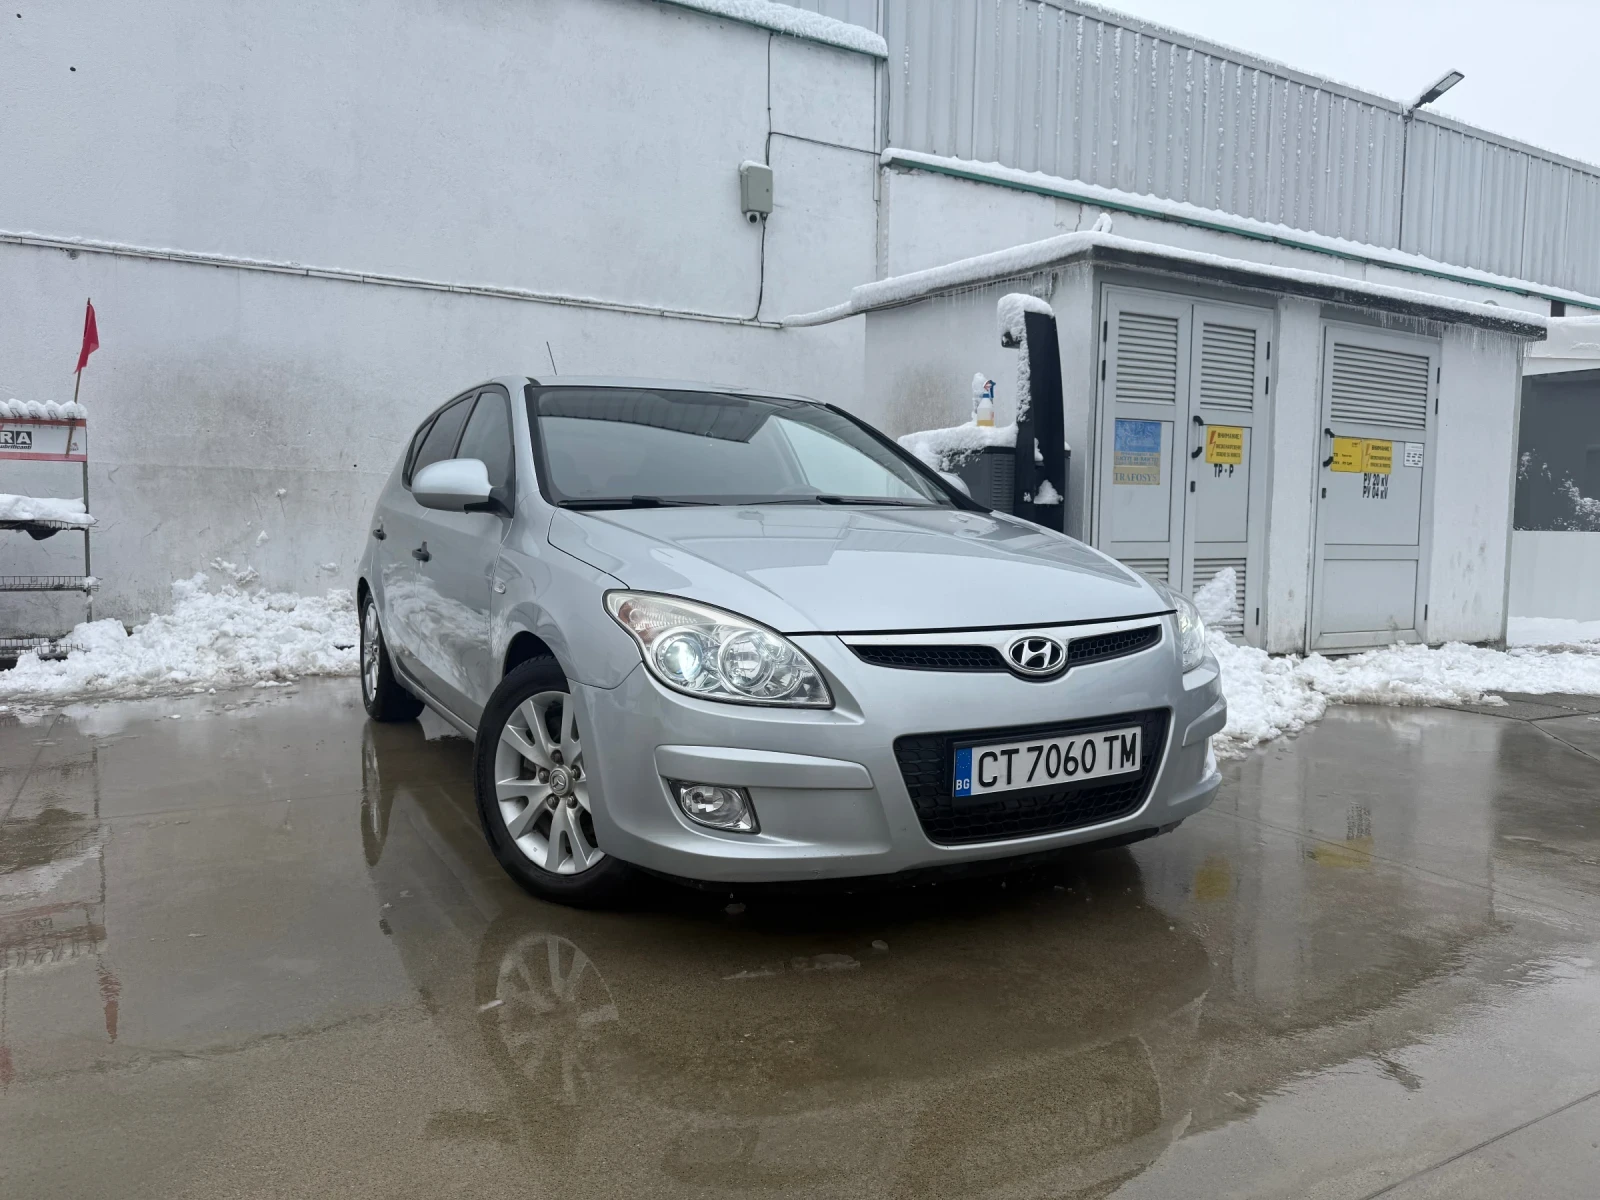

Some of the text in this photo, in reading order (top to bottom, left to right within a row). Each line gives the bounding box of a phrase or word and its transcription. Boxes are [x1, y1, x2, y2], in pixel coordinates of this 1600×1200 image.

[1114, 472, 1157, 482] TRAFOSYS
[1372, 473, 1380, 487] 20
[1371, 486, 1380, 499] 04
[978, 732, 1137, 788] CT 7060 TM
[955, 778, 970, 791] BG
